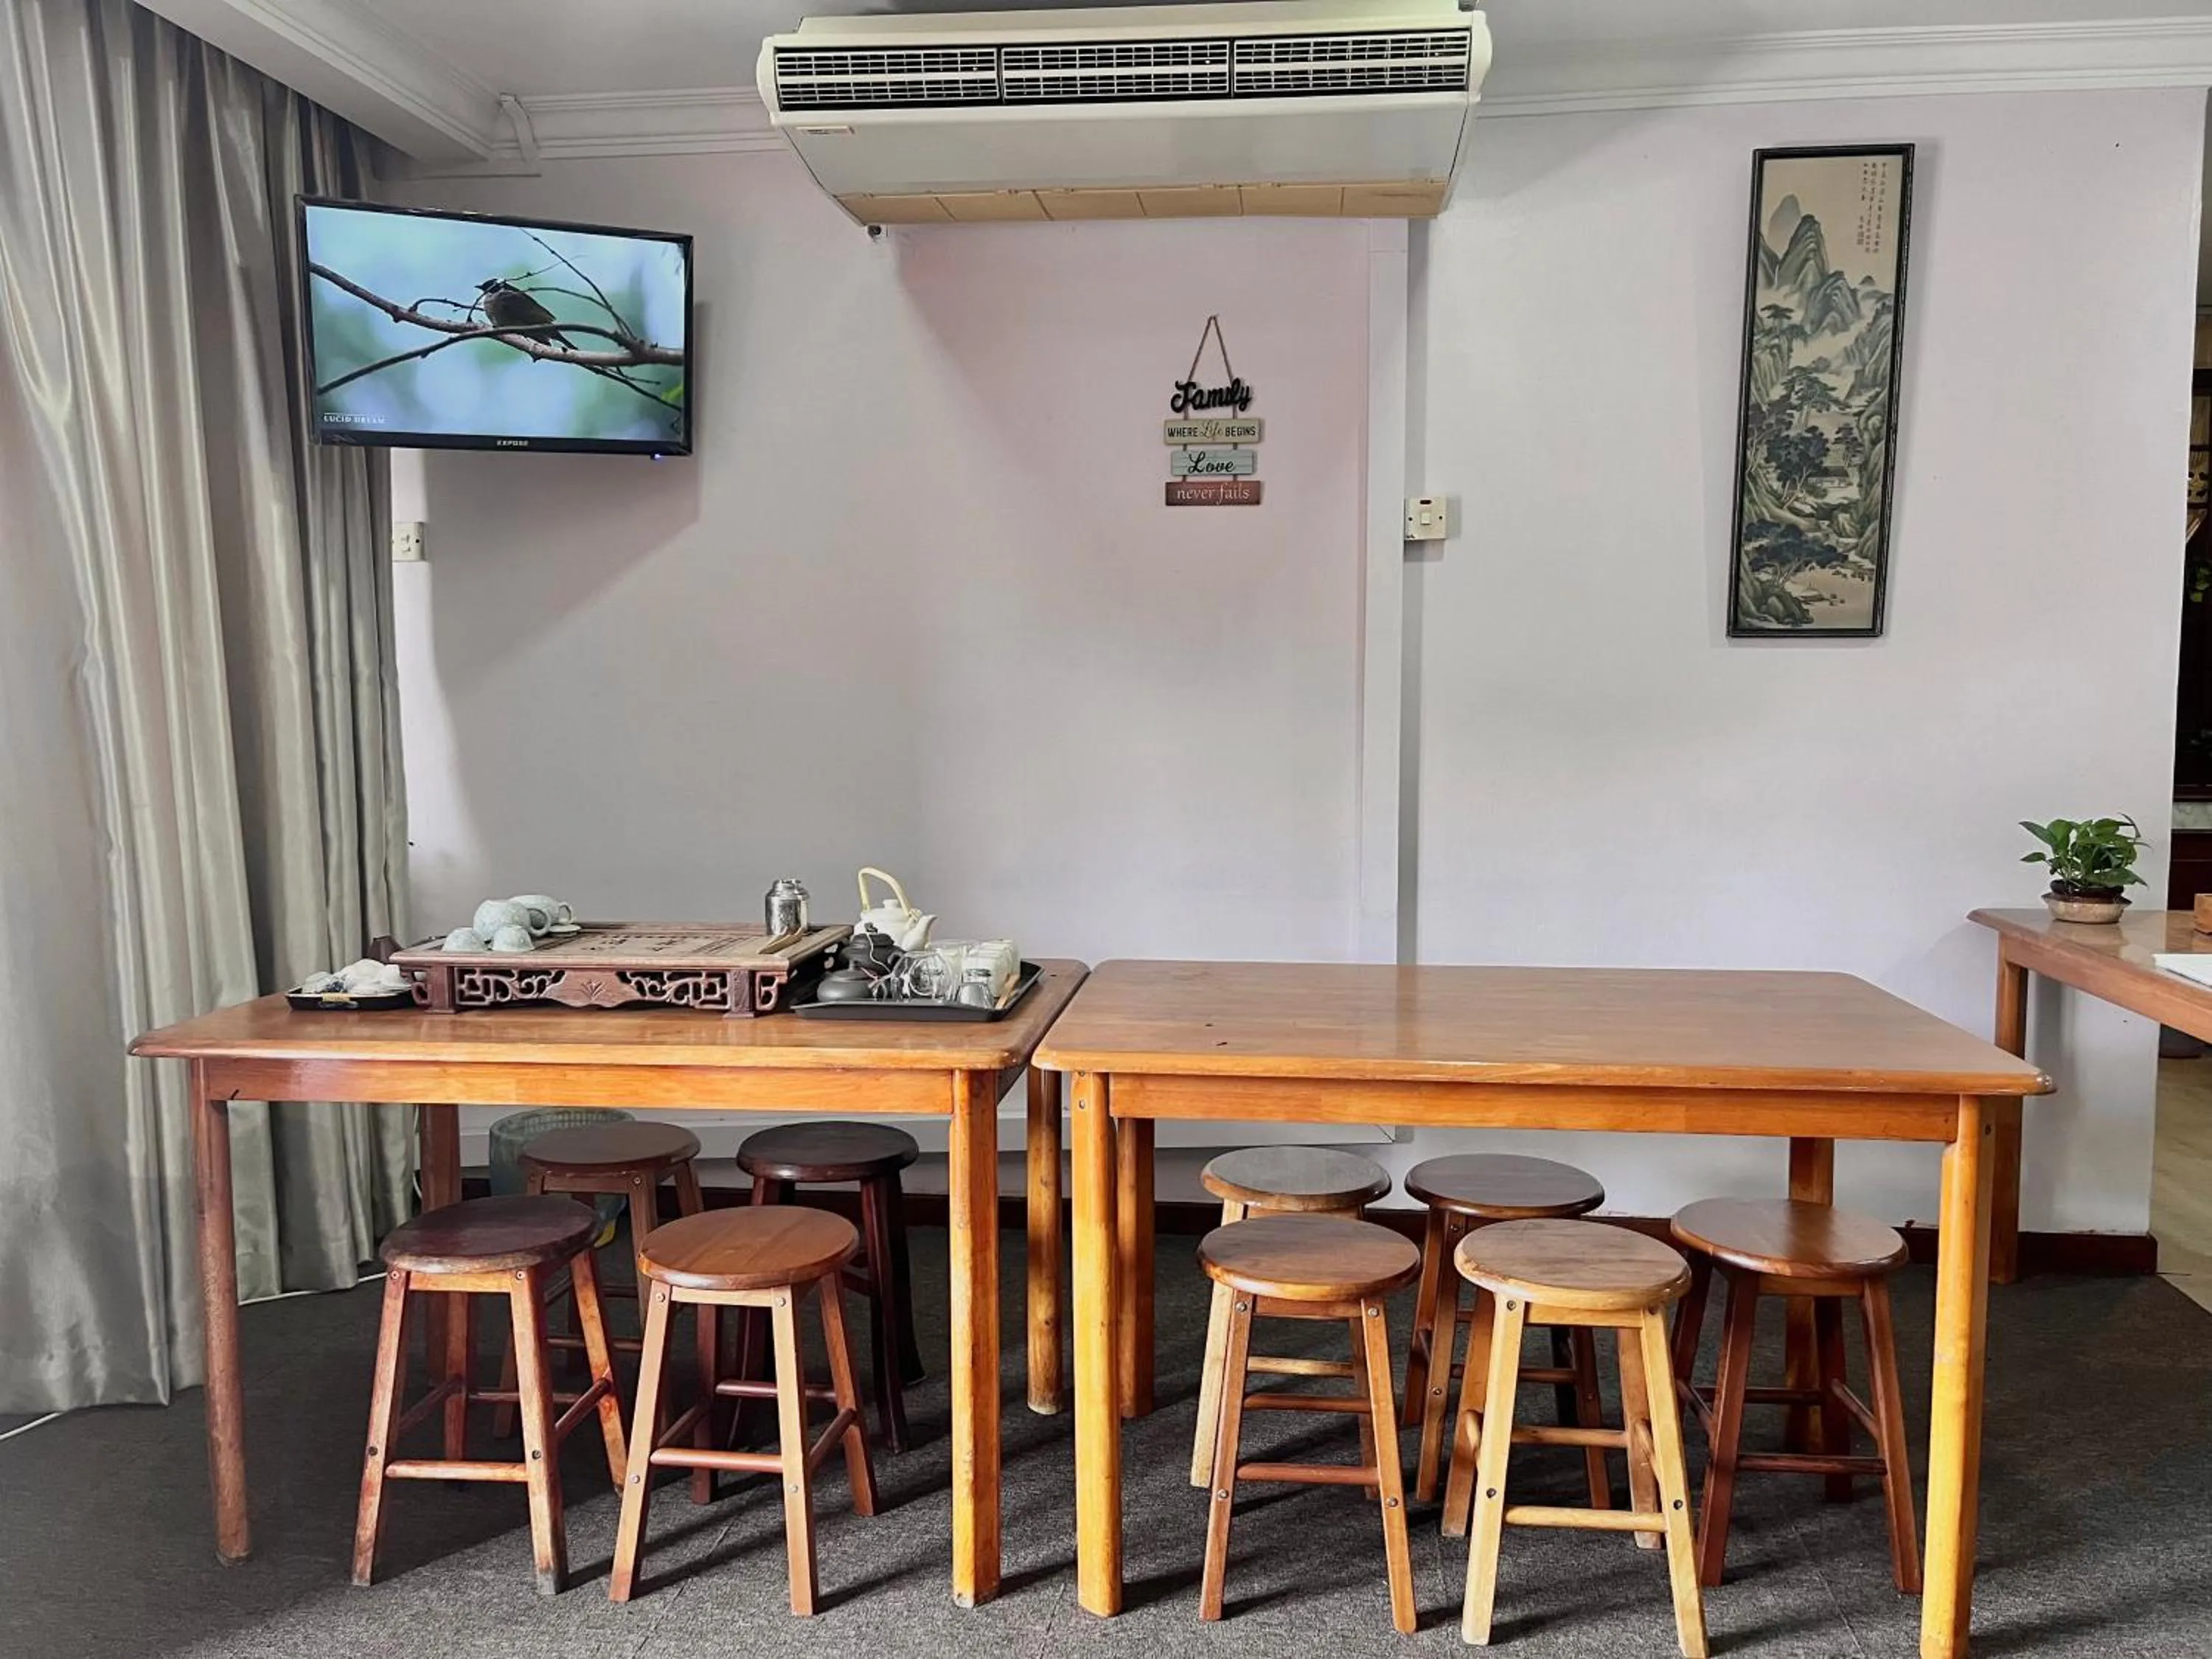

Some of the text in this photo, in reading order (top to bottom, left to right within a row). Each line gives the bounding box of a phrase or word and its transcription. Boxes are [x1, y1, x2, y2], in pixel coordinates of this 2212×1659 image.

[1171, 378, 1252, 413] Family
[1167, 427, 1198, 437] WHERE
[1225, 426, 1256, 437] BEGINS
[1188, 451, 1234, 473] Love
[1177, 482, 1251, 504] never fails
